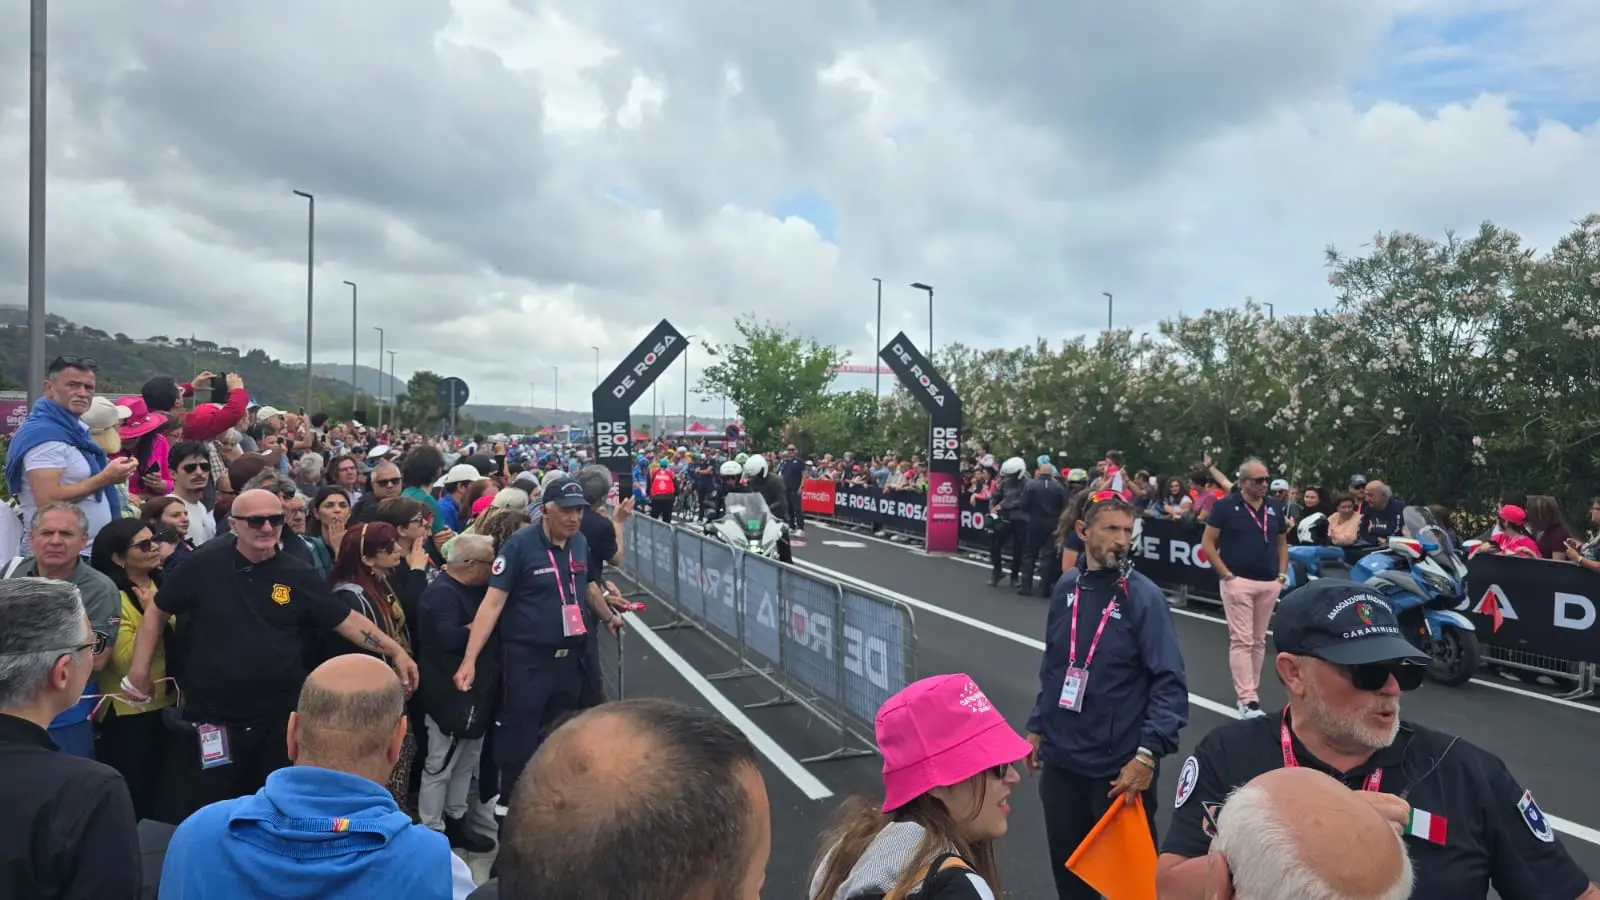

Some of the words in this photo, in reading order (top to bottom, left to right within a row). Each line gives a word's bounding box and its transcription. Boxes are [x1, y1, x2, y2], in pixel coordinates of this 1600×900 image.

[612, 375, 636, 399] DE
[633, 335, 677, 376] ROSA
[891, 343, 913, 365] DE
[910, 364, 945, 407] ROSA
[597, 421, 627, 434] DE
[932, 427, 958, 439] DE
[597, 434, 629, 446] RO
[932, 438, 959, 450] RO
[598, 445, 629, 458] SA
[932, 449, 958, 460] SA
[835, 491, 848, 506] DE
[850, 493, 877, 512] ROSA
[879, 499, 896, 516] DE
[960, 510, 985, 530] RO
[1143, 536, 1160, 560] E
[1169, 539, 1212, 569] RO
